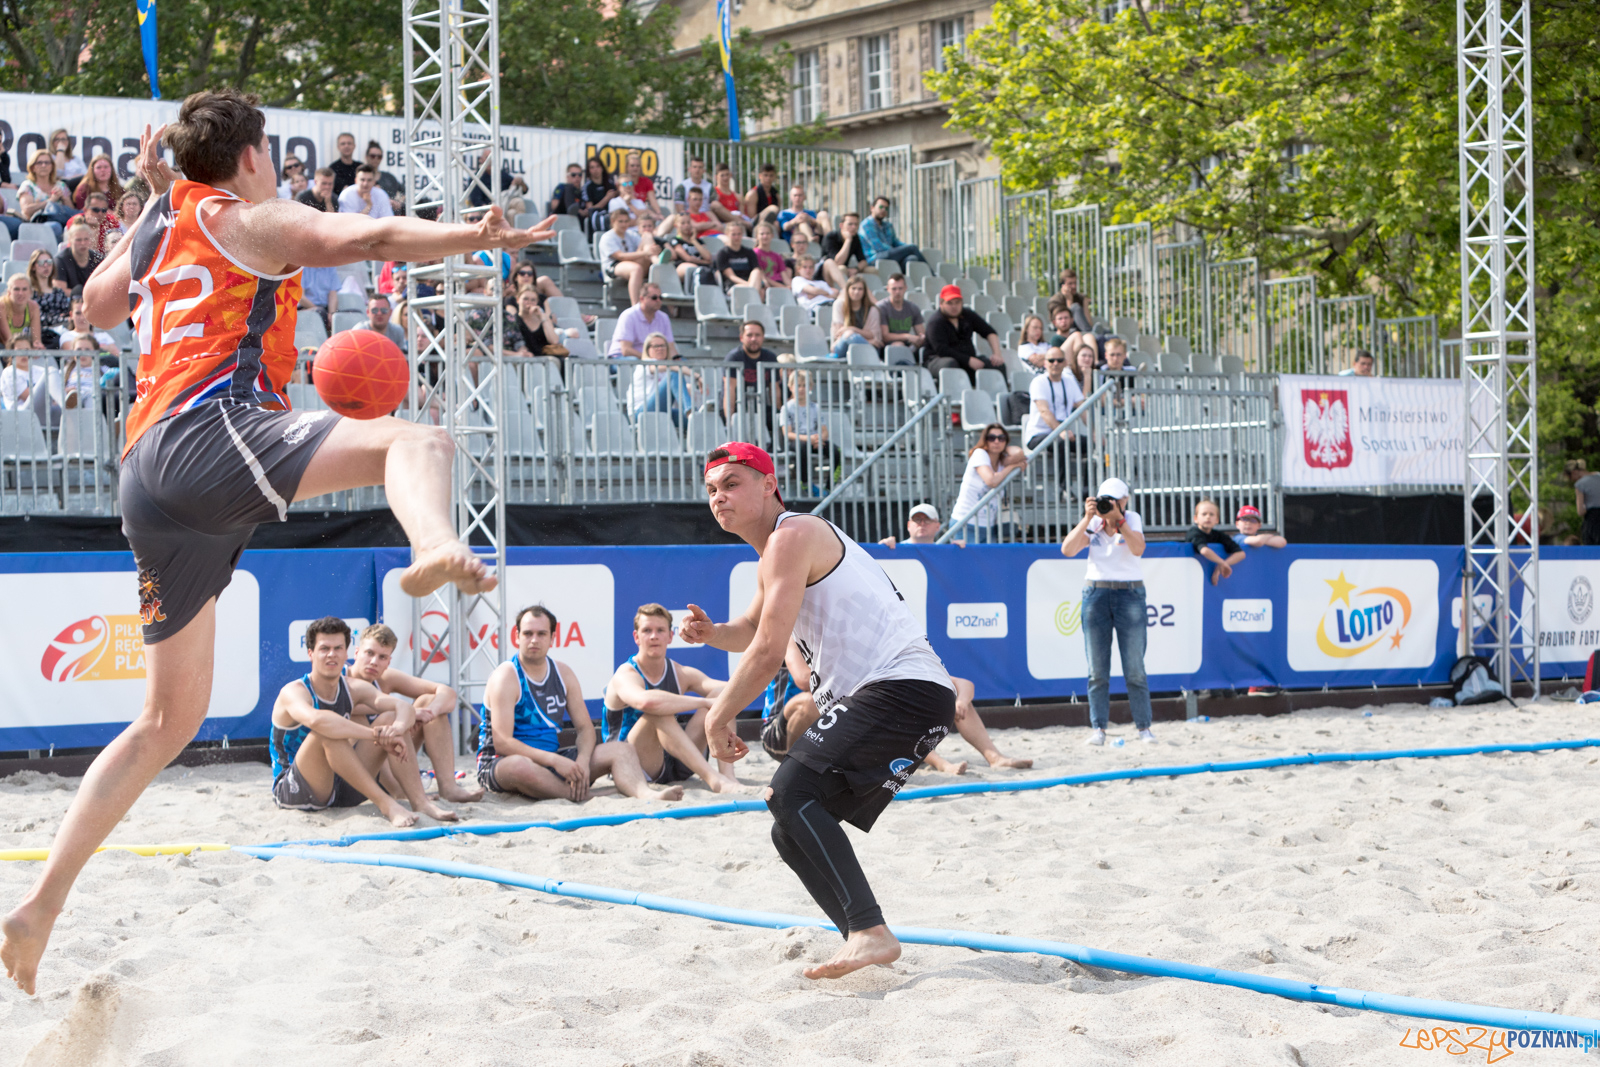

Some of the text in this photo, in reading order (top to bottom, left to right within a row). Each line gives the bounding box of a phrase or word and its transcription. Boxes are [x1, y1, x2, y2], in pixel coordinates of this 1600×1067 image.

[386, 150, 436, 168] BECH
[584, 143, 659, 178] LOTO
[1359, 406, 1448, 423] Ministerstwo
[1361, 435, 1409, 454] Sportu
[1420, 436, 1478, 454] Turysty
[114, 624, 144, 637] PIŁK
[1336, 600, 1394, 643] LOTTO
[114, 655, 146, 670] PLA
[817, 703, 848, 730] 5
